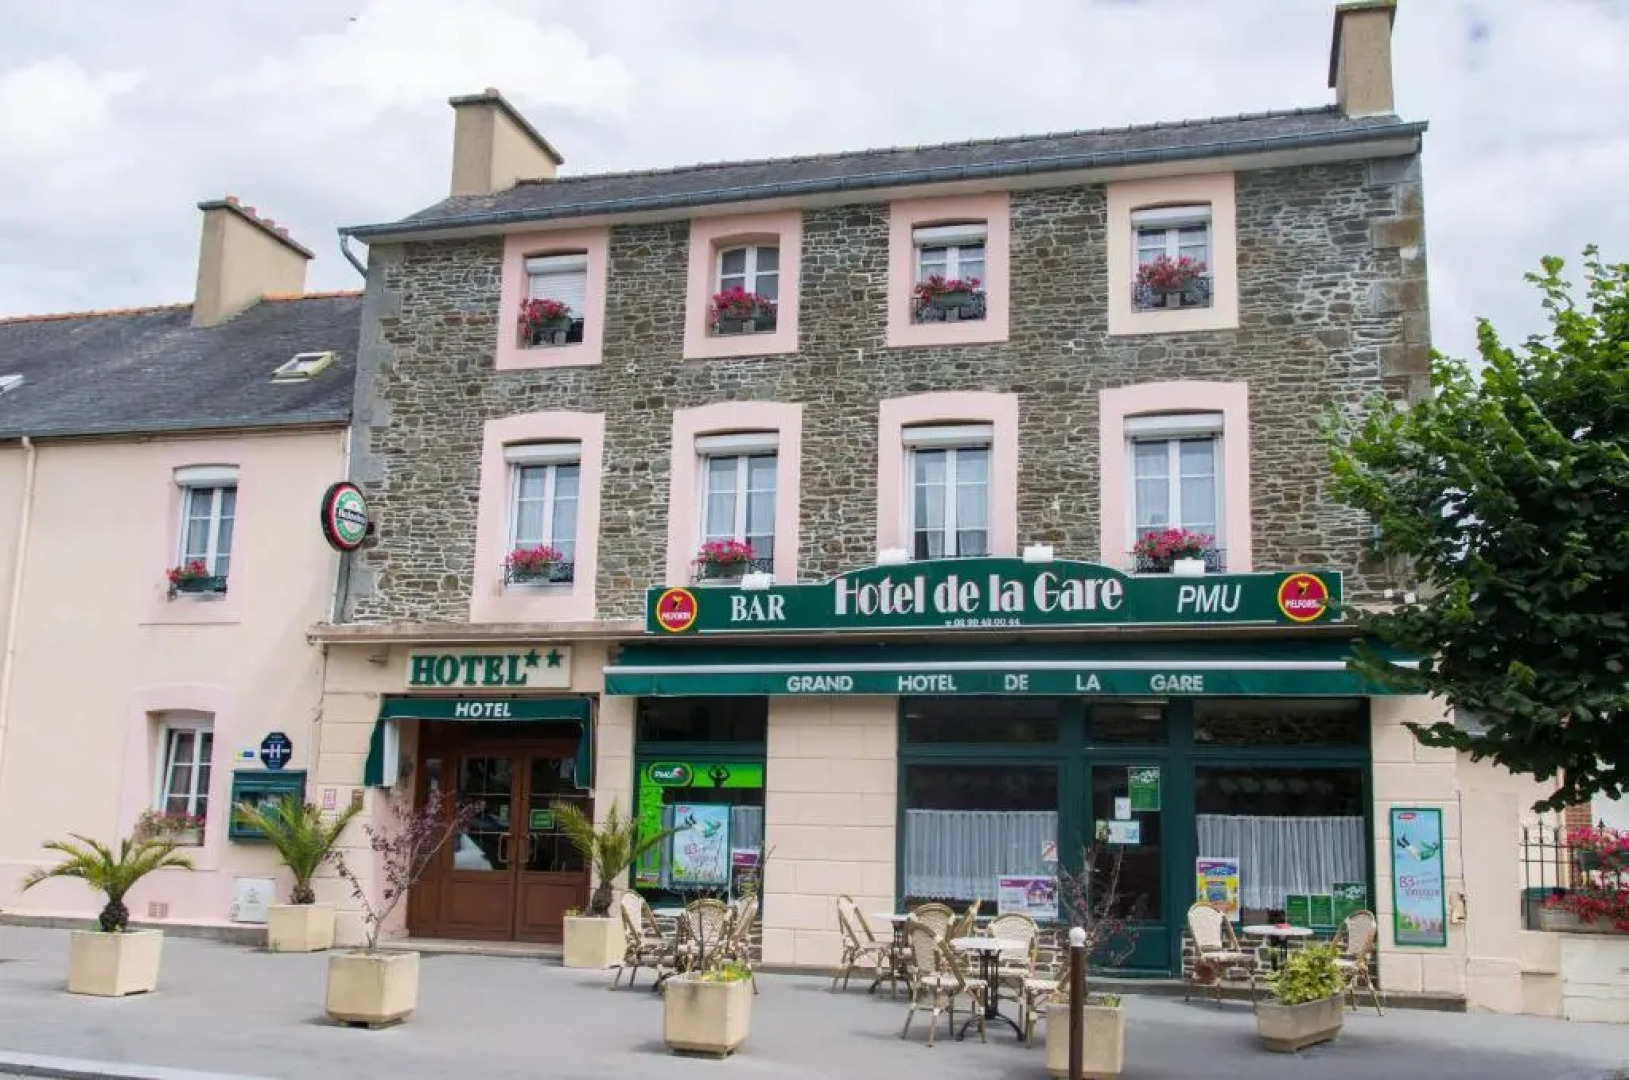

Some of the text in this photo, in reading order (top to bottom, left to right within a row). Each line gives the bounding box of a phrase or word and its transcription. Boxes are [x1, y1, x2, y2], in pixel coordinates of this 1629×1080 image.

[834, 571, 1124, 615] Hotel de la Gare
[1177, 584, 1241, 614] PMU
[730, 594, 786, 622] BAR
[409, 654, 527, 686] HOTEL
[786, 674, 1204, 692] GRAND HOTEL DE LA GARE
[455, 702, 512, 717] HOTEL
